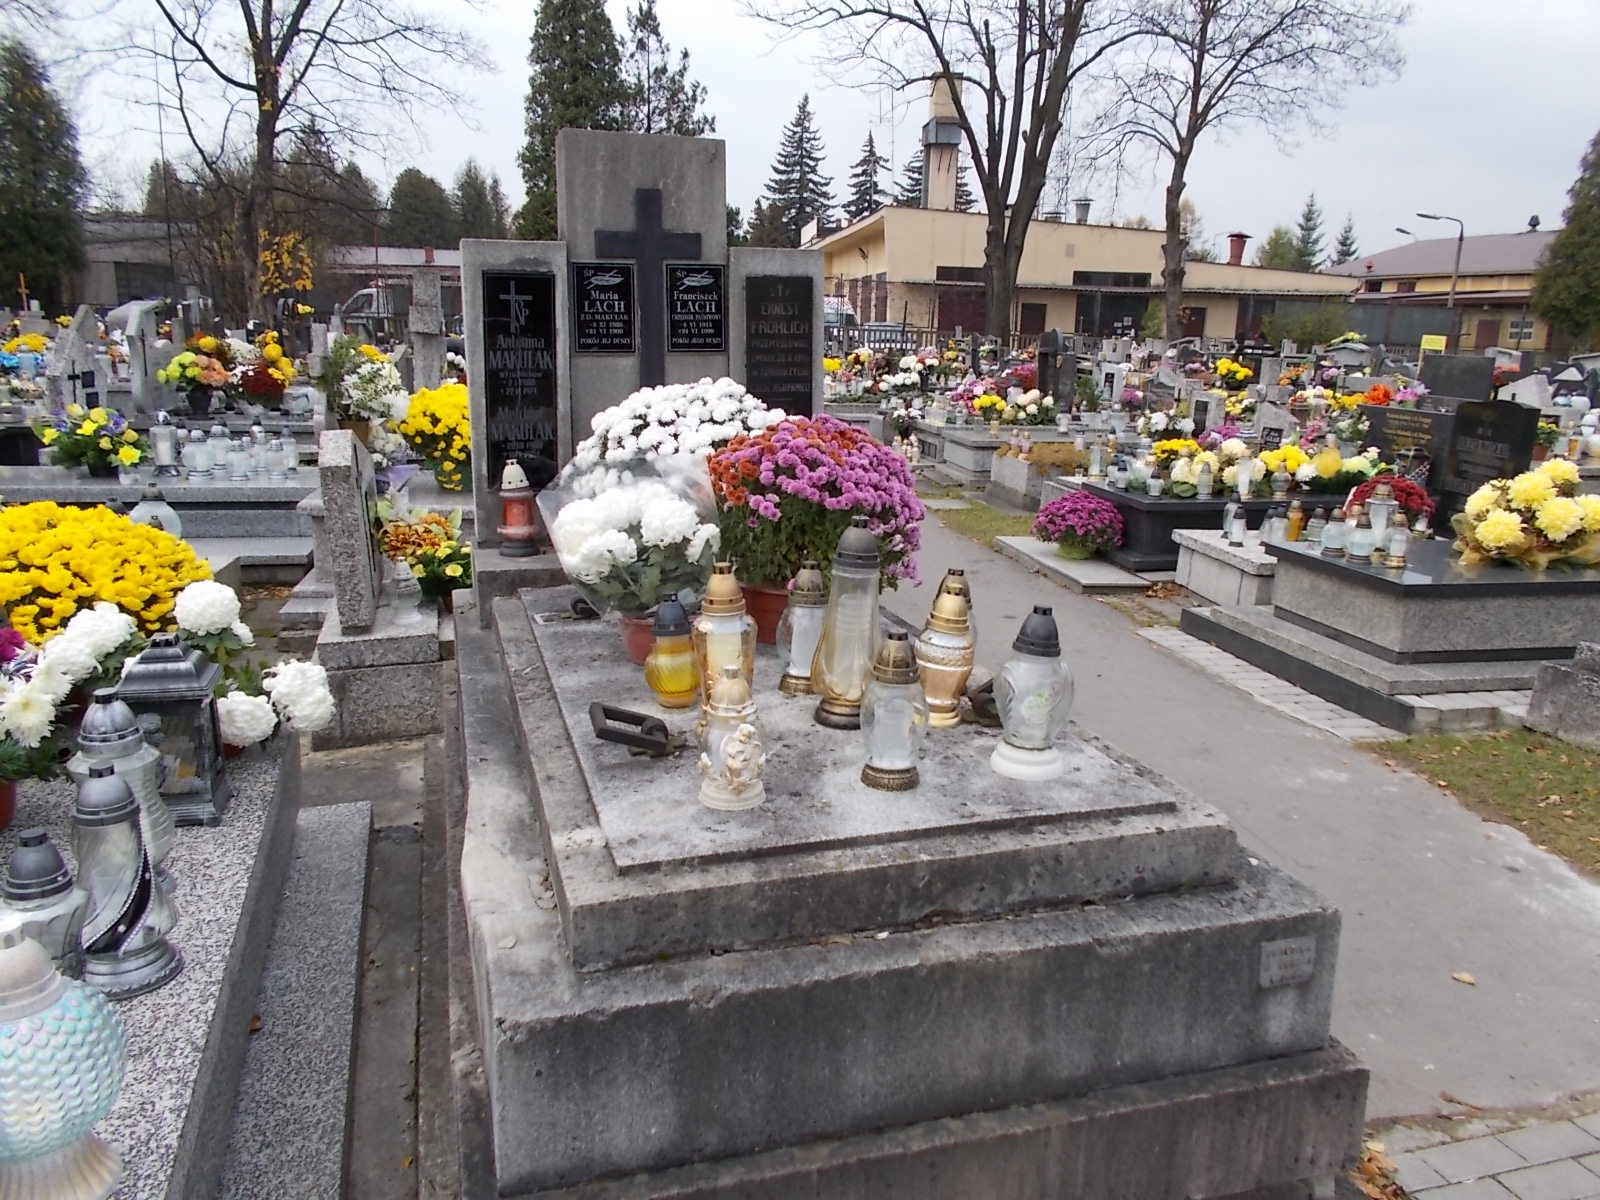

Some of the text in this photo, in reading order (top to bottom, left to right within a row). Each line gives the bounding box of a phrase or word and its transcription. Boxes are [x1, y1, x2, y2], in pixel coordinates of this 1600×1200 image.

[590, 290, 619, 300] Maria
[673, 290, 719, 301] Franciszek
[583, 300, 626, 313] LACH
[676, 301, 717, 313] LACH
[761, 302, 800, 315] ERNEST
